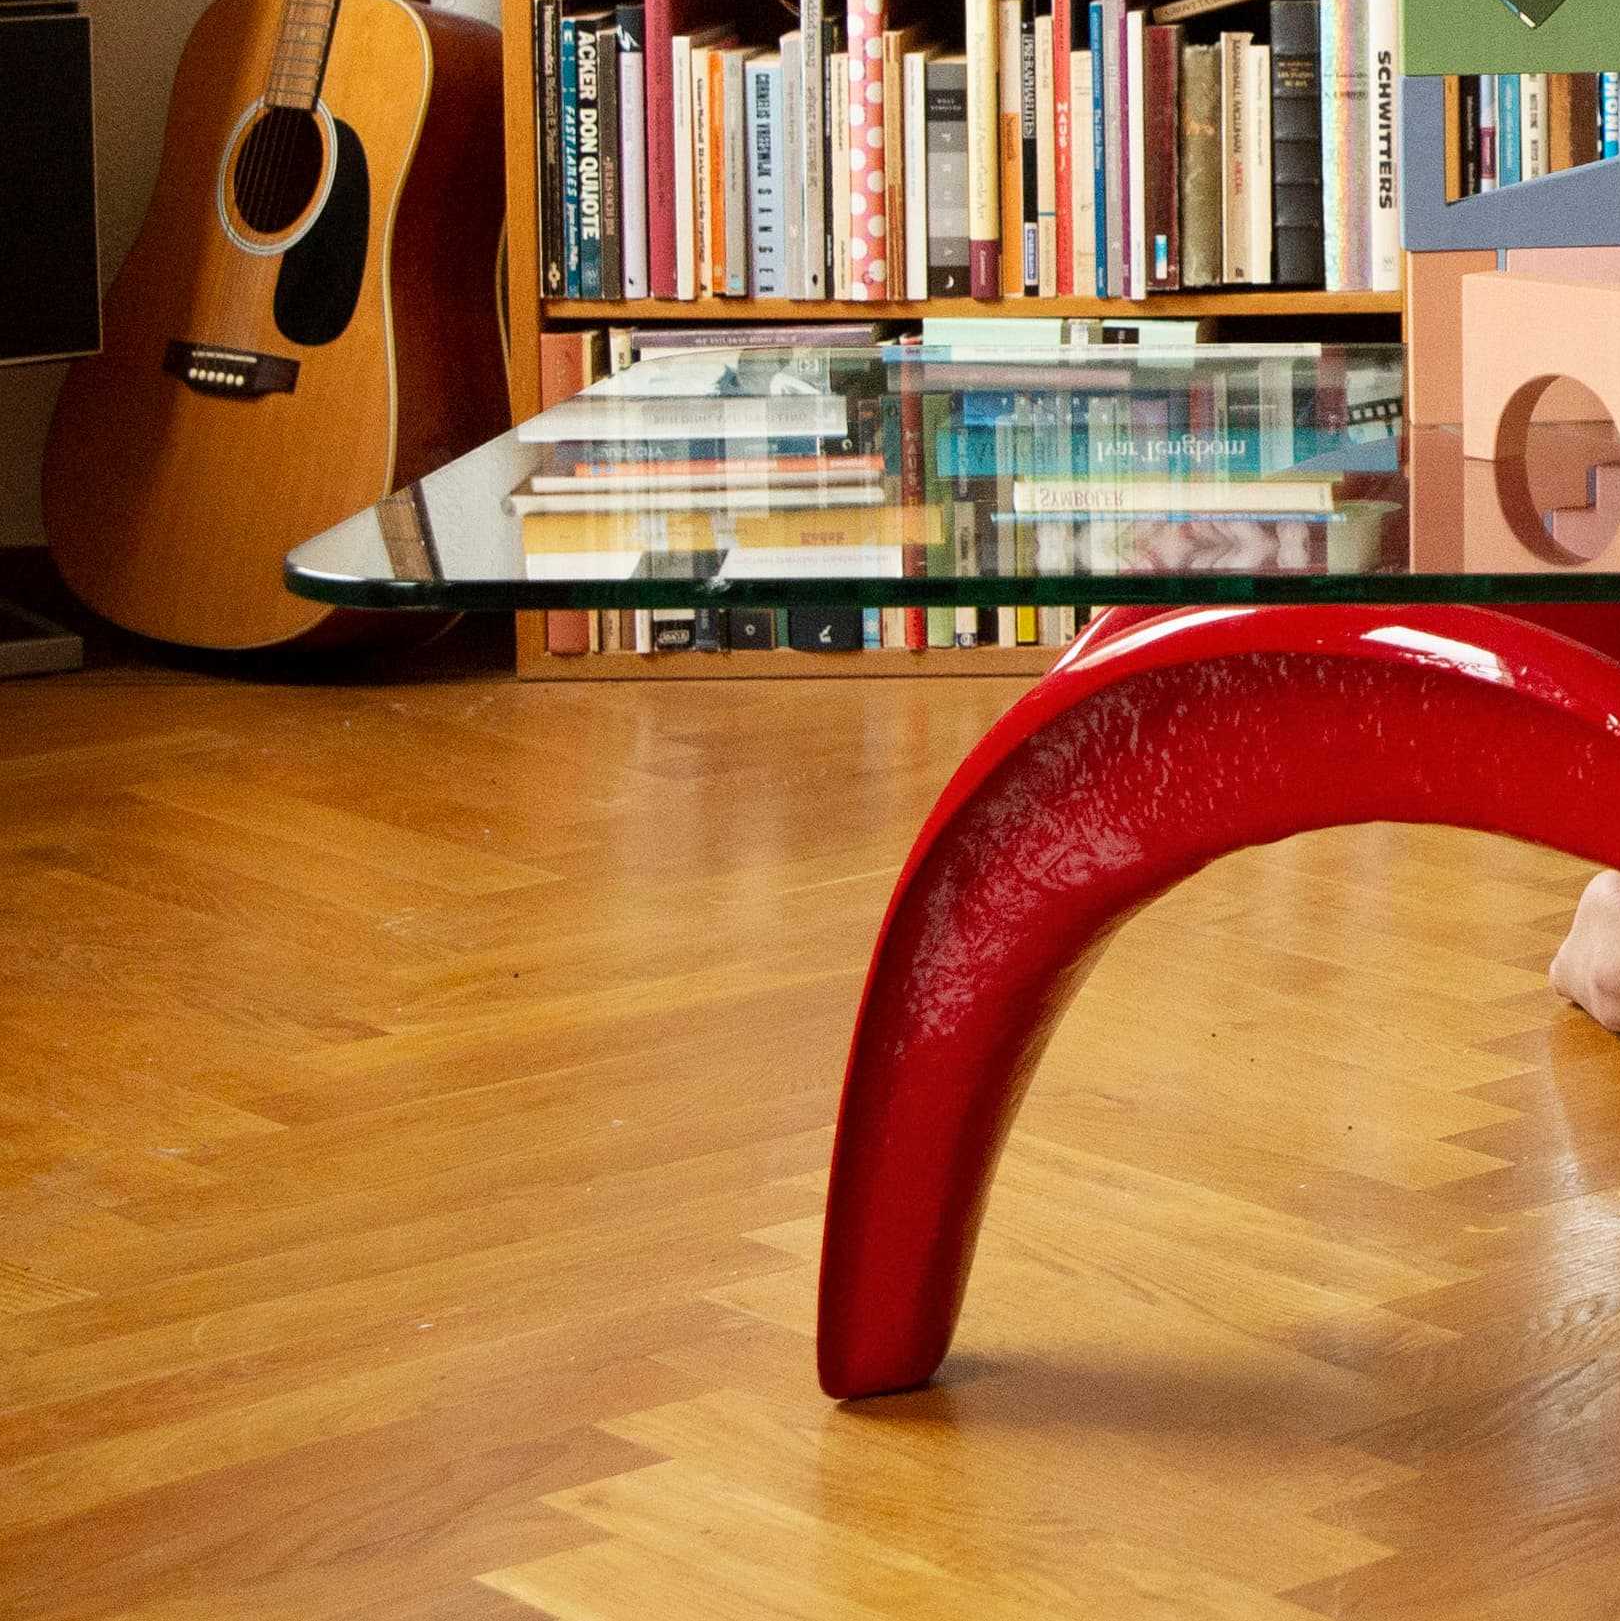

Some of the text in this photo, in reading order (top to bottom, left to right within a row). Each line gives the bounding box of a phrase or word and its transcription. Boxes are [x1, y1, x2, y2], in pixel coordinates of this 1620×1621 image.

[564, 105, 576, 141] FAST
[755, 73, 771, 119] CORNELIS
[578, 30, 600, 241] ACKER DON QUIJOTE
[756, 123, 772, 177] VREESWIJK
[1377, 50, 1393, 209] SCHWITTERS
